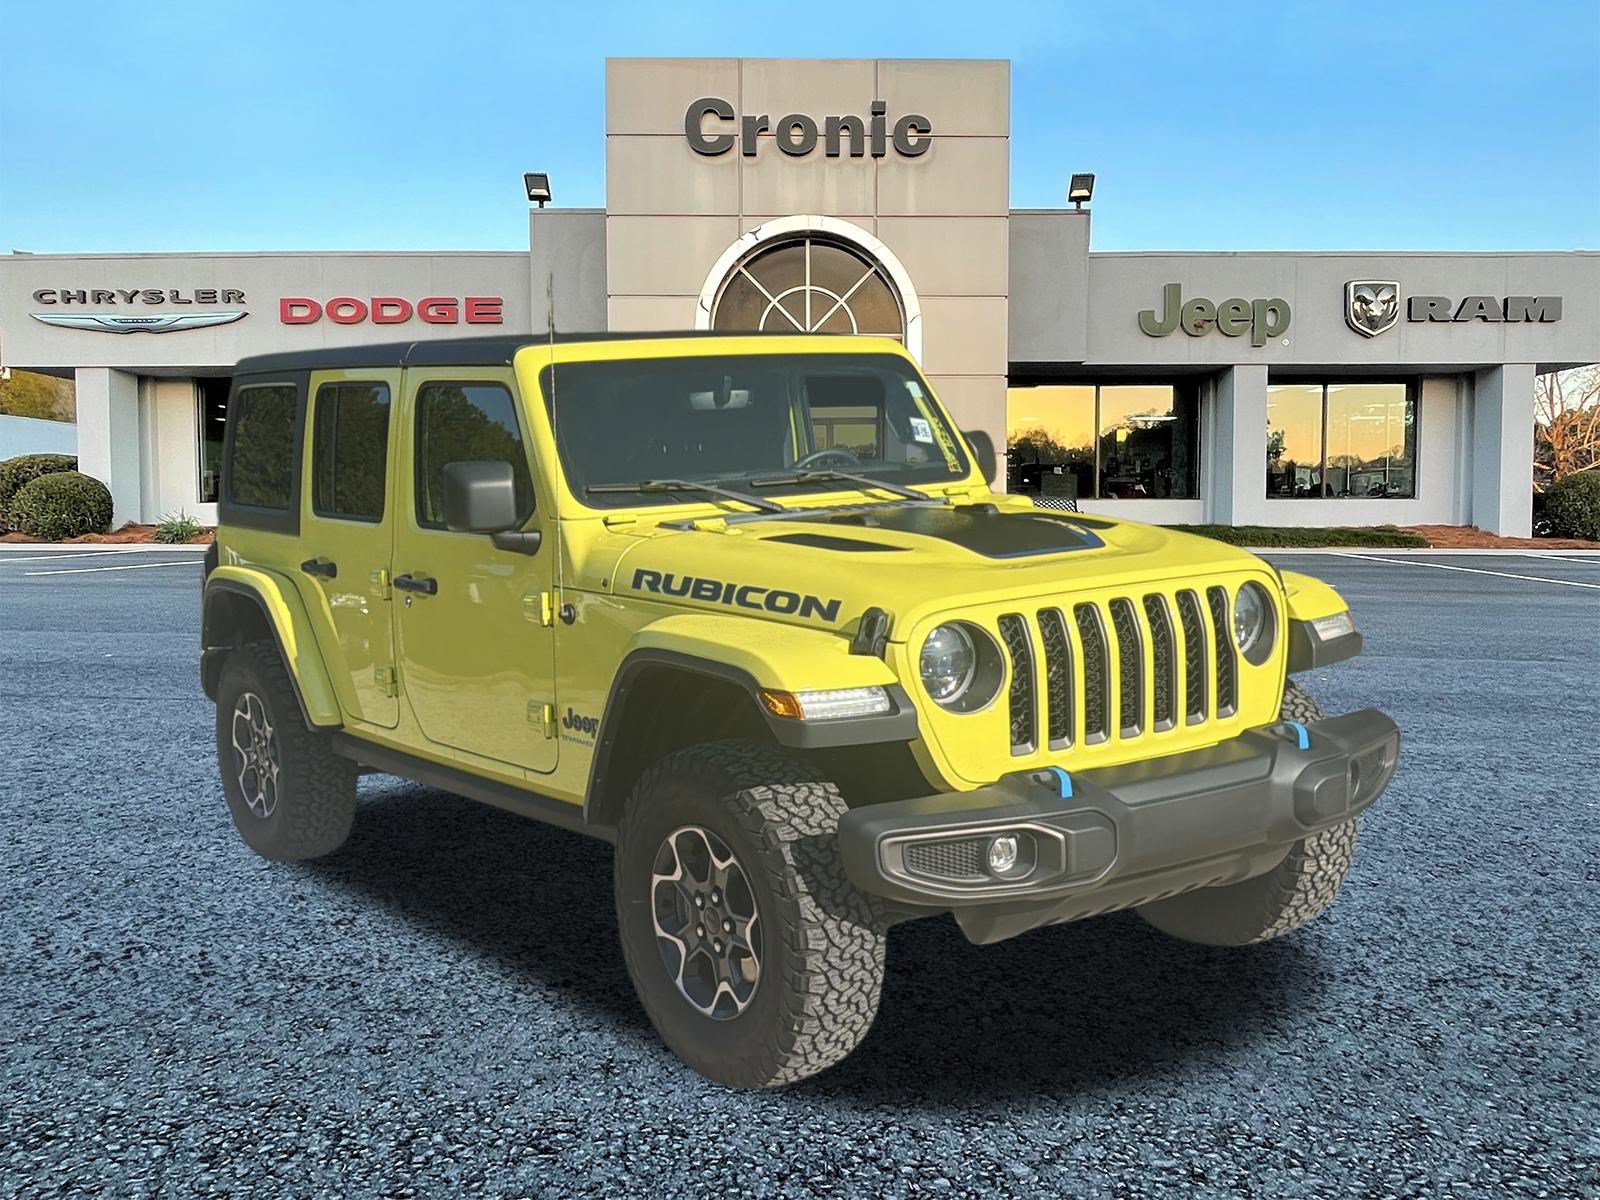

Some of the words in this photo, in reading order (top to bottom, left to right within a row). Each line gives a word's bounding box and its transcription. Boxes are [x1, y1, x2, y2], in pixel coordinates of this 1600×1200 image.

[685, 97, 932, 157] Cronic
[32, 288, 247, 304] CHRYSLER
[279, 297, 503, 324] DODGE
[1138, 283, 1291, 347] Jeep
[1407, 296, 1563, 322] RAM
[631, 568, 842, 622] RUBICON
